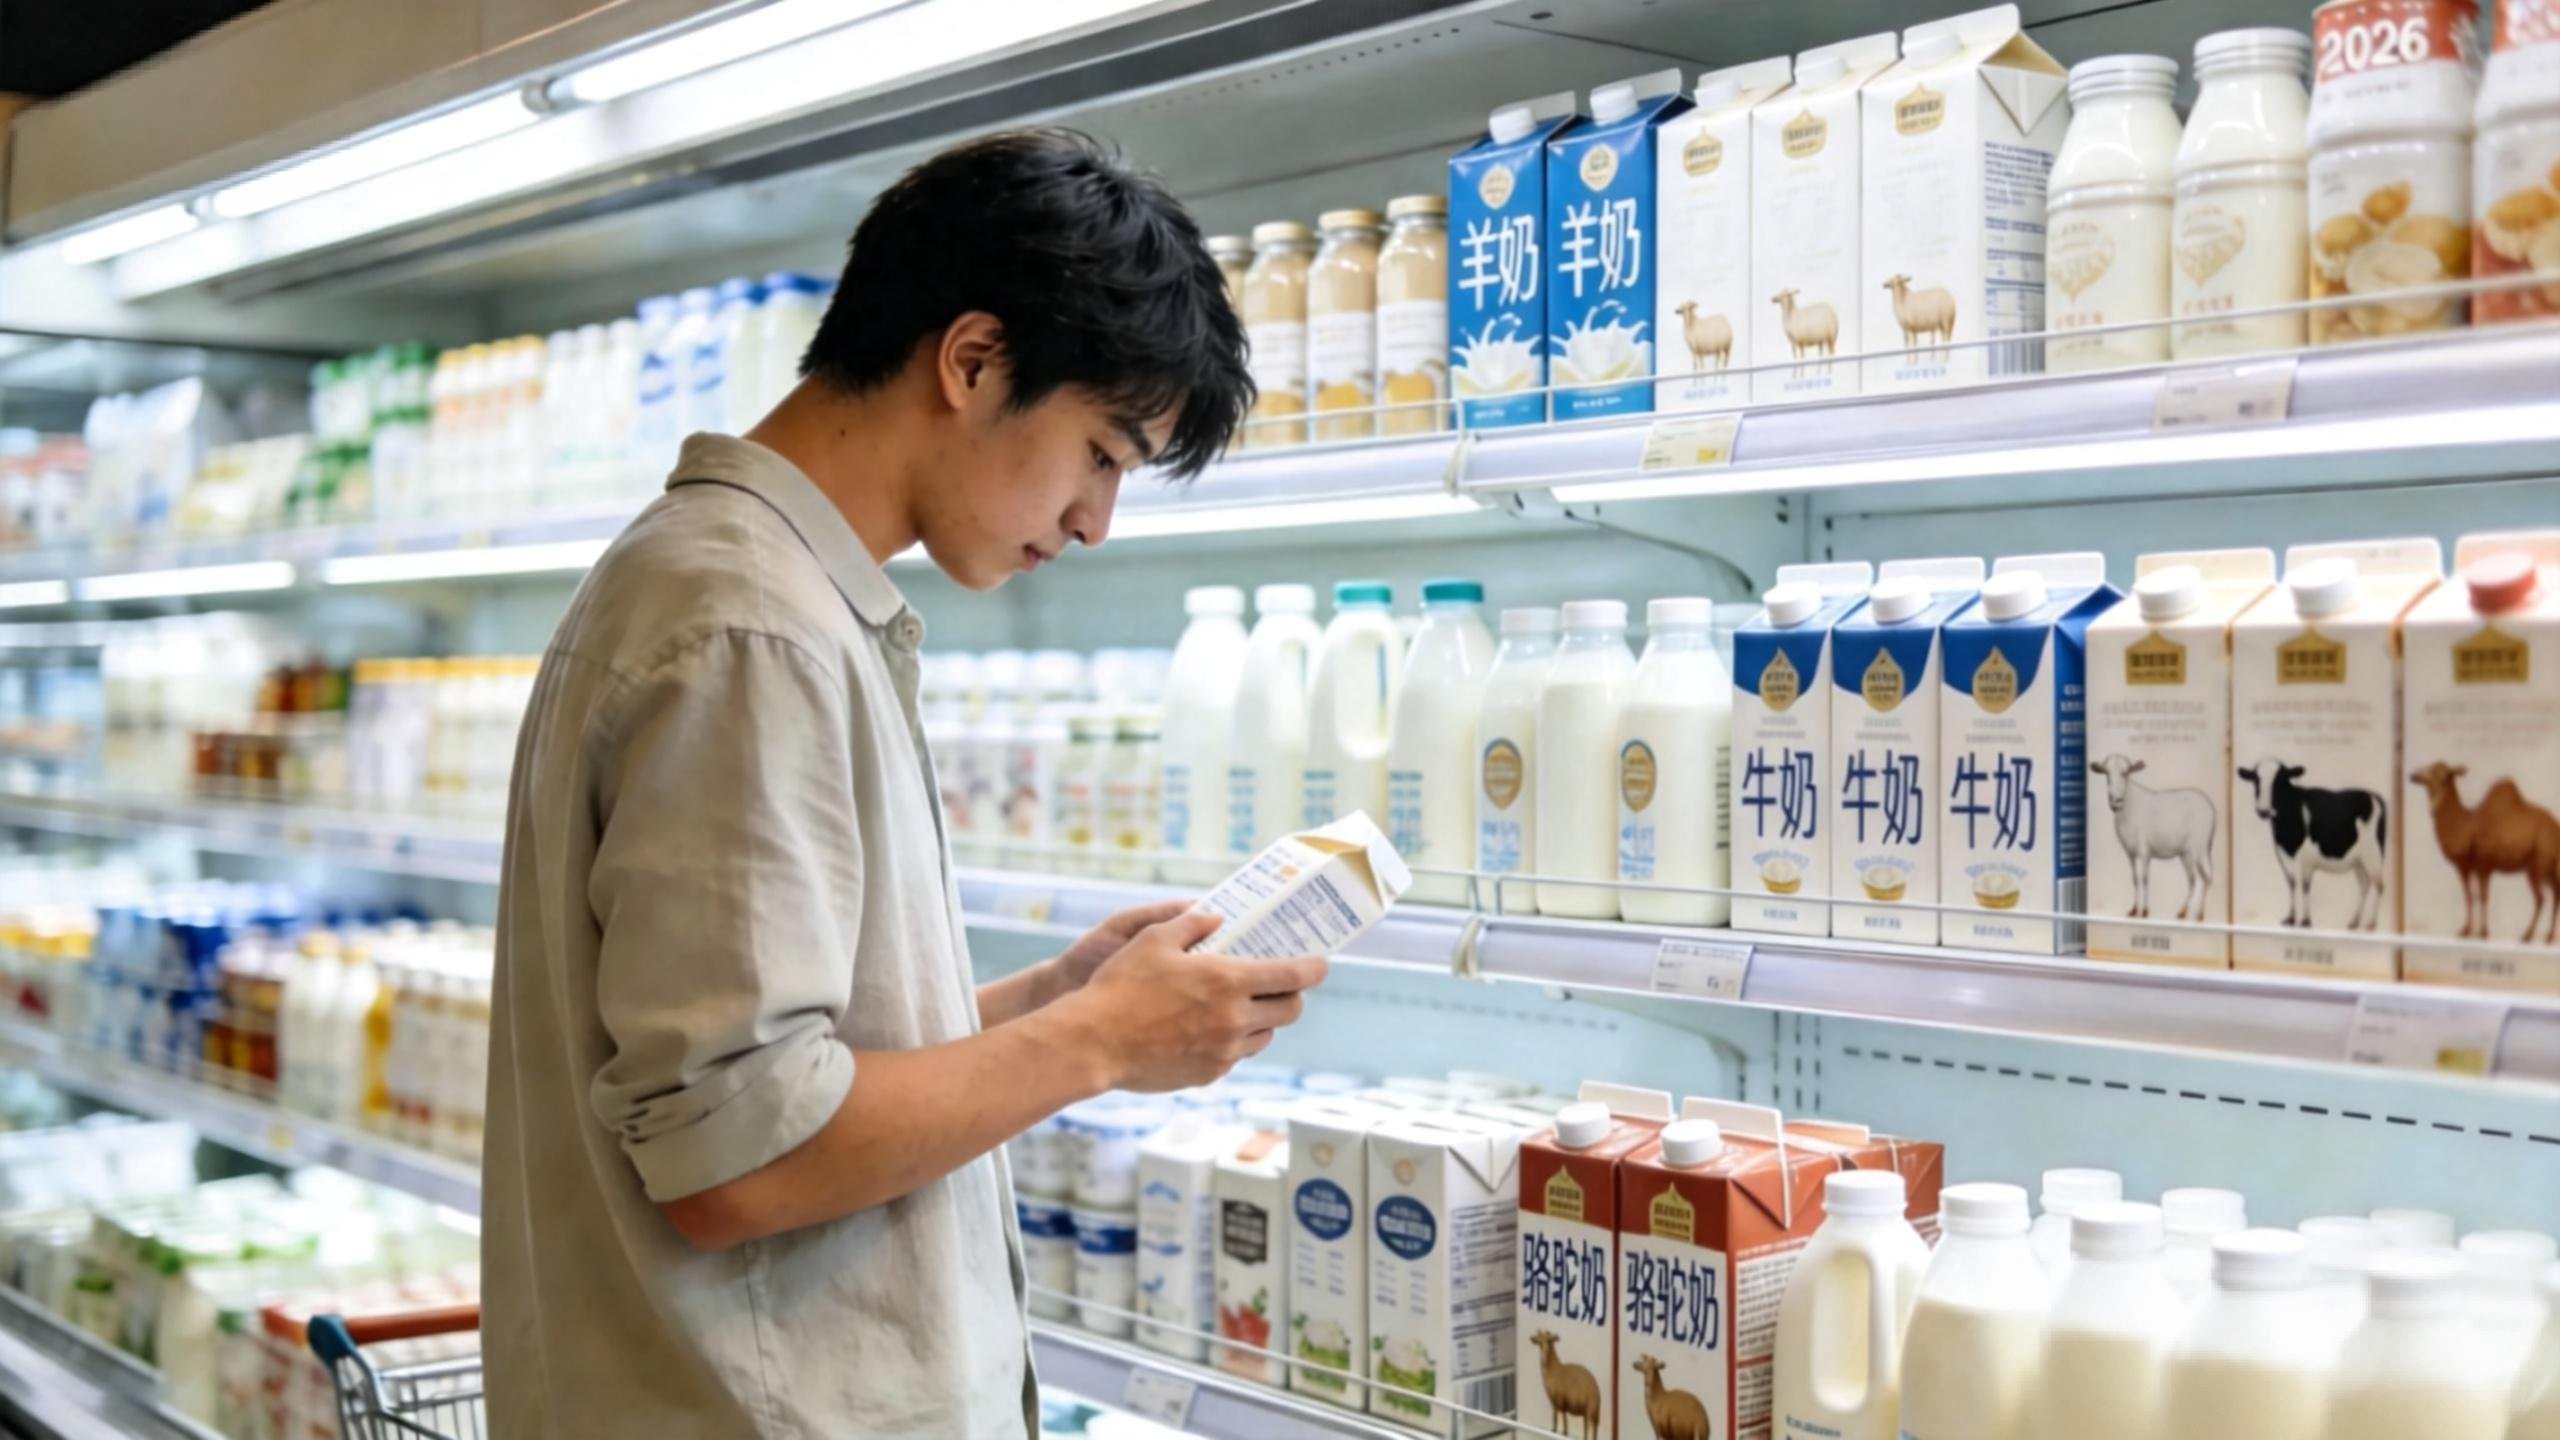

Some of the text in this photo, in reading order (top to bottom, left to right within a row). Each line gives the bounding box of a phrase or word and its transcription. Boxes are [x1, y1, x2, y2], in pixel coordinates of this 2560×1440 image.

[2319, 17, 2430, 74] 2026
[1458, 214, 1539, 310] 羊奶
[1558, 198, 1641, 298] 羊奶
[1741, 747, 1817, 839] 牛奶
[1842, 748, 1924, 847] 牛奶
[1950, 752, 2036, 851] 牛奶
[1625, 1249, 1719, 1350] 骆驼奶
